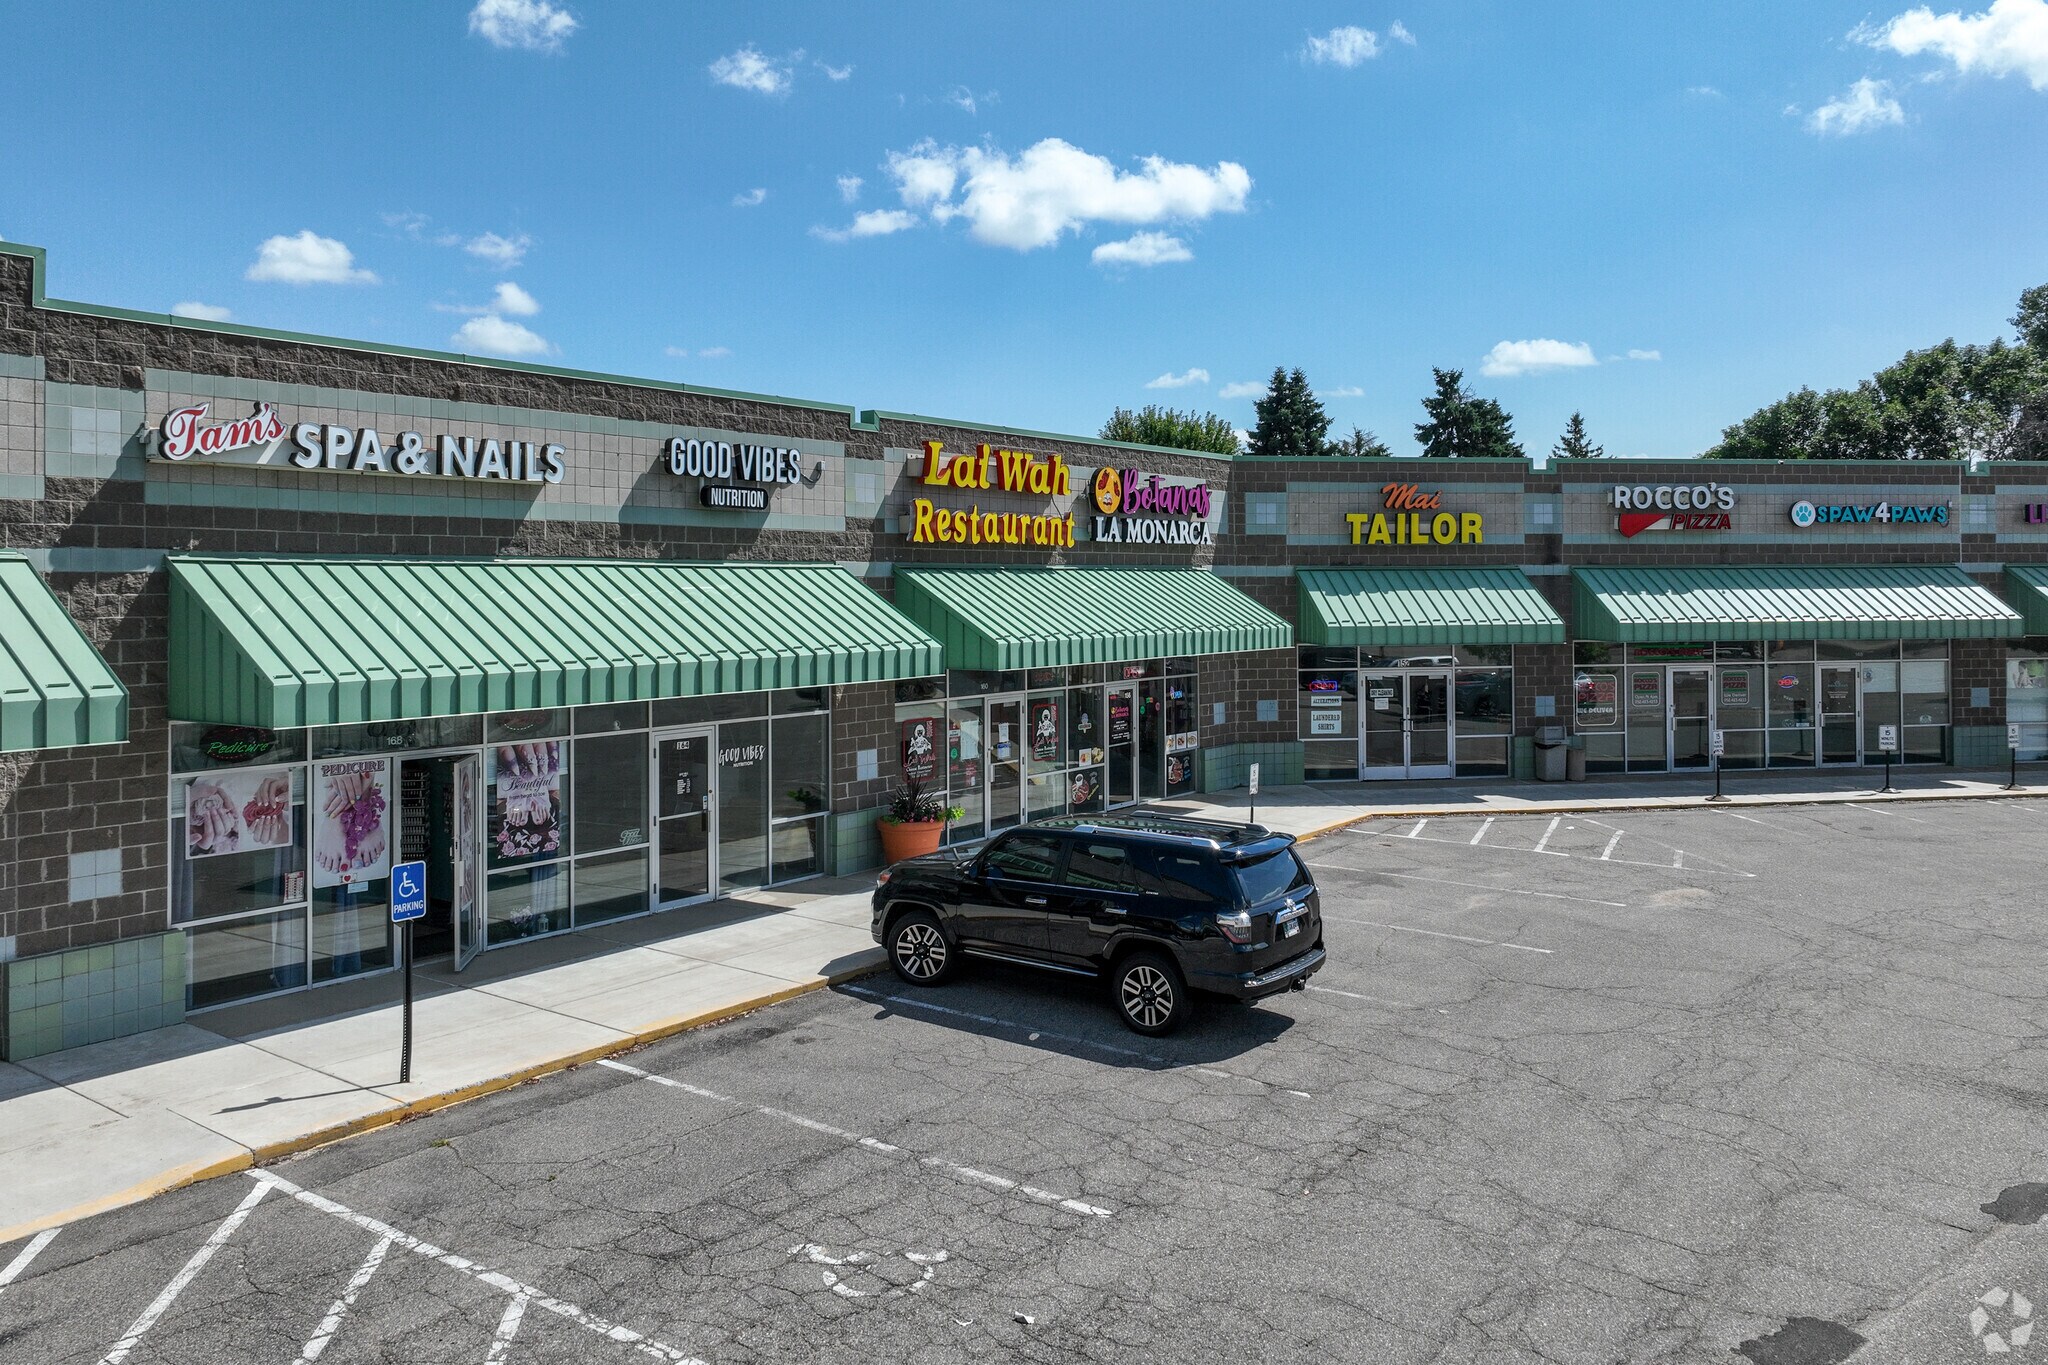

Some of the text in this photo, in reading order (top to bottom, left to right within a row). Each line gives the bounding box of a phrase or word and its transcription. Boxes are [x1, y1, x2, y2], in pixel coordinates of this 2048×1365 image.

[162, 401, 567, 484] Tam's SPA & NAILS
[667, 437, 801, 484] GOOD VIBES
[995, 450, 1071, 497] Wah
[710, 487, 765, 509] NUTRITION
[1119, 468, 1212, 518] Botanas
[1381, 482, 1444, 510] Mai
[1613, 482, 1736, 510] ROCCO'S
[909, 498, 1075, 548] Restaurant
[1092, 515, 1213, 545] LA MONARCA
[1345, 512, 1484, 545] TAILOR
[1671, 513, 1732, 530] PIZZA
[1577, 681, 1616, 692] CO'S
[1578, 692, 1615, 702] PIZZA
[207, 741, 269, 754] Pedicure
[386, 735, 403, 746] 168
[719, 744, 767, 766] GOOD VIBES
[320, 760, 385, 777] PEDICURE
[502, 774, 554, 791] Beautiful
[393, 899, 424, 914] PARKING
